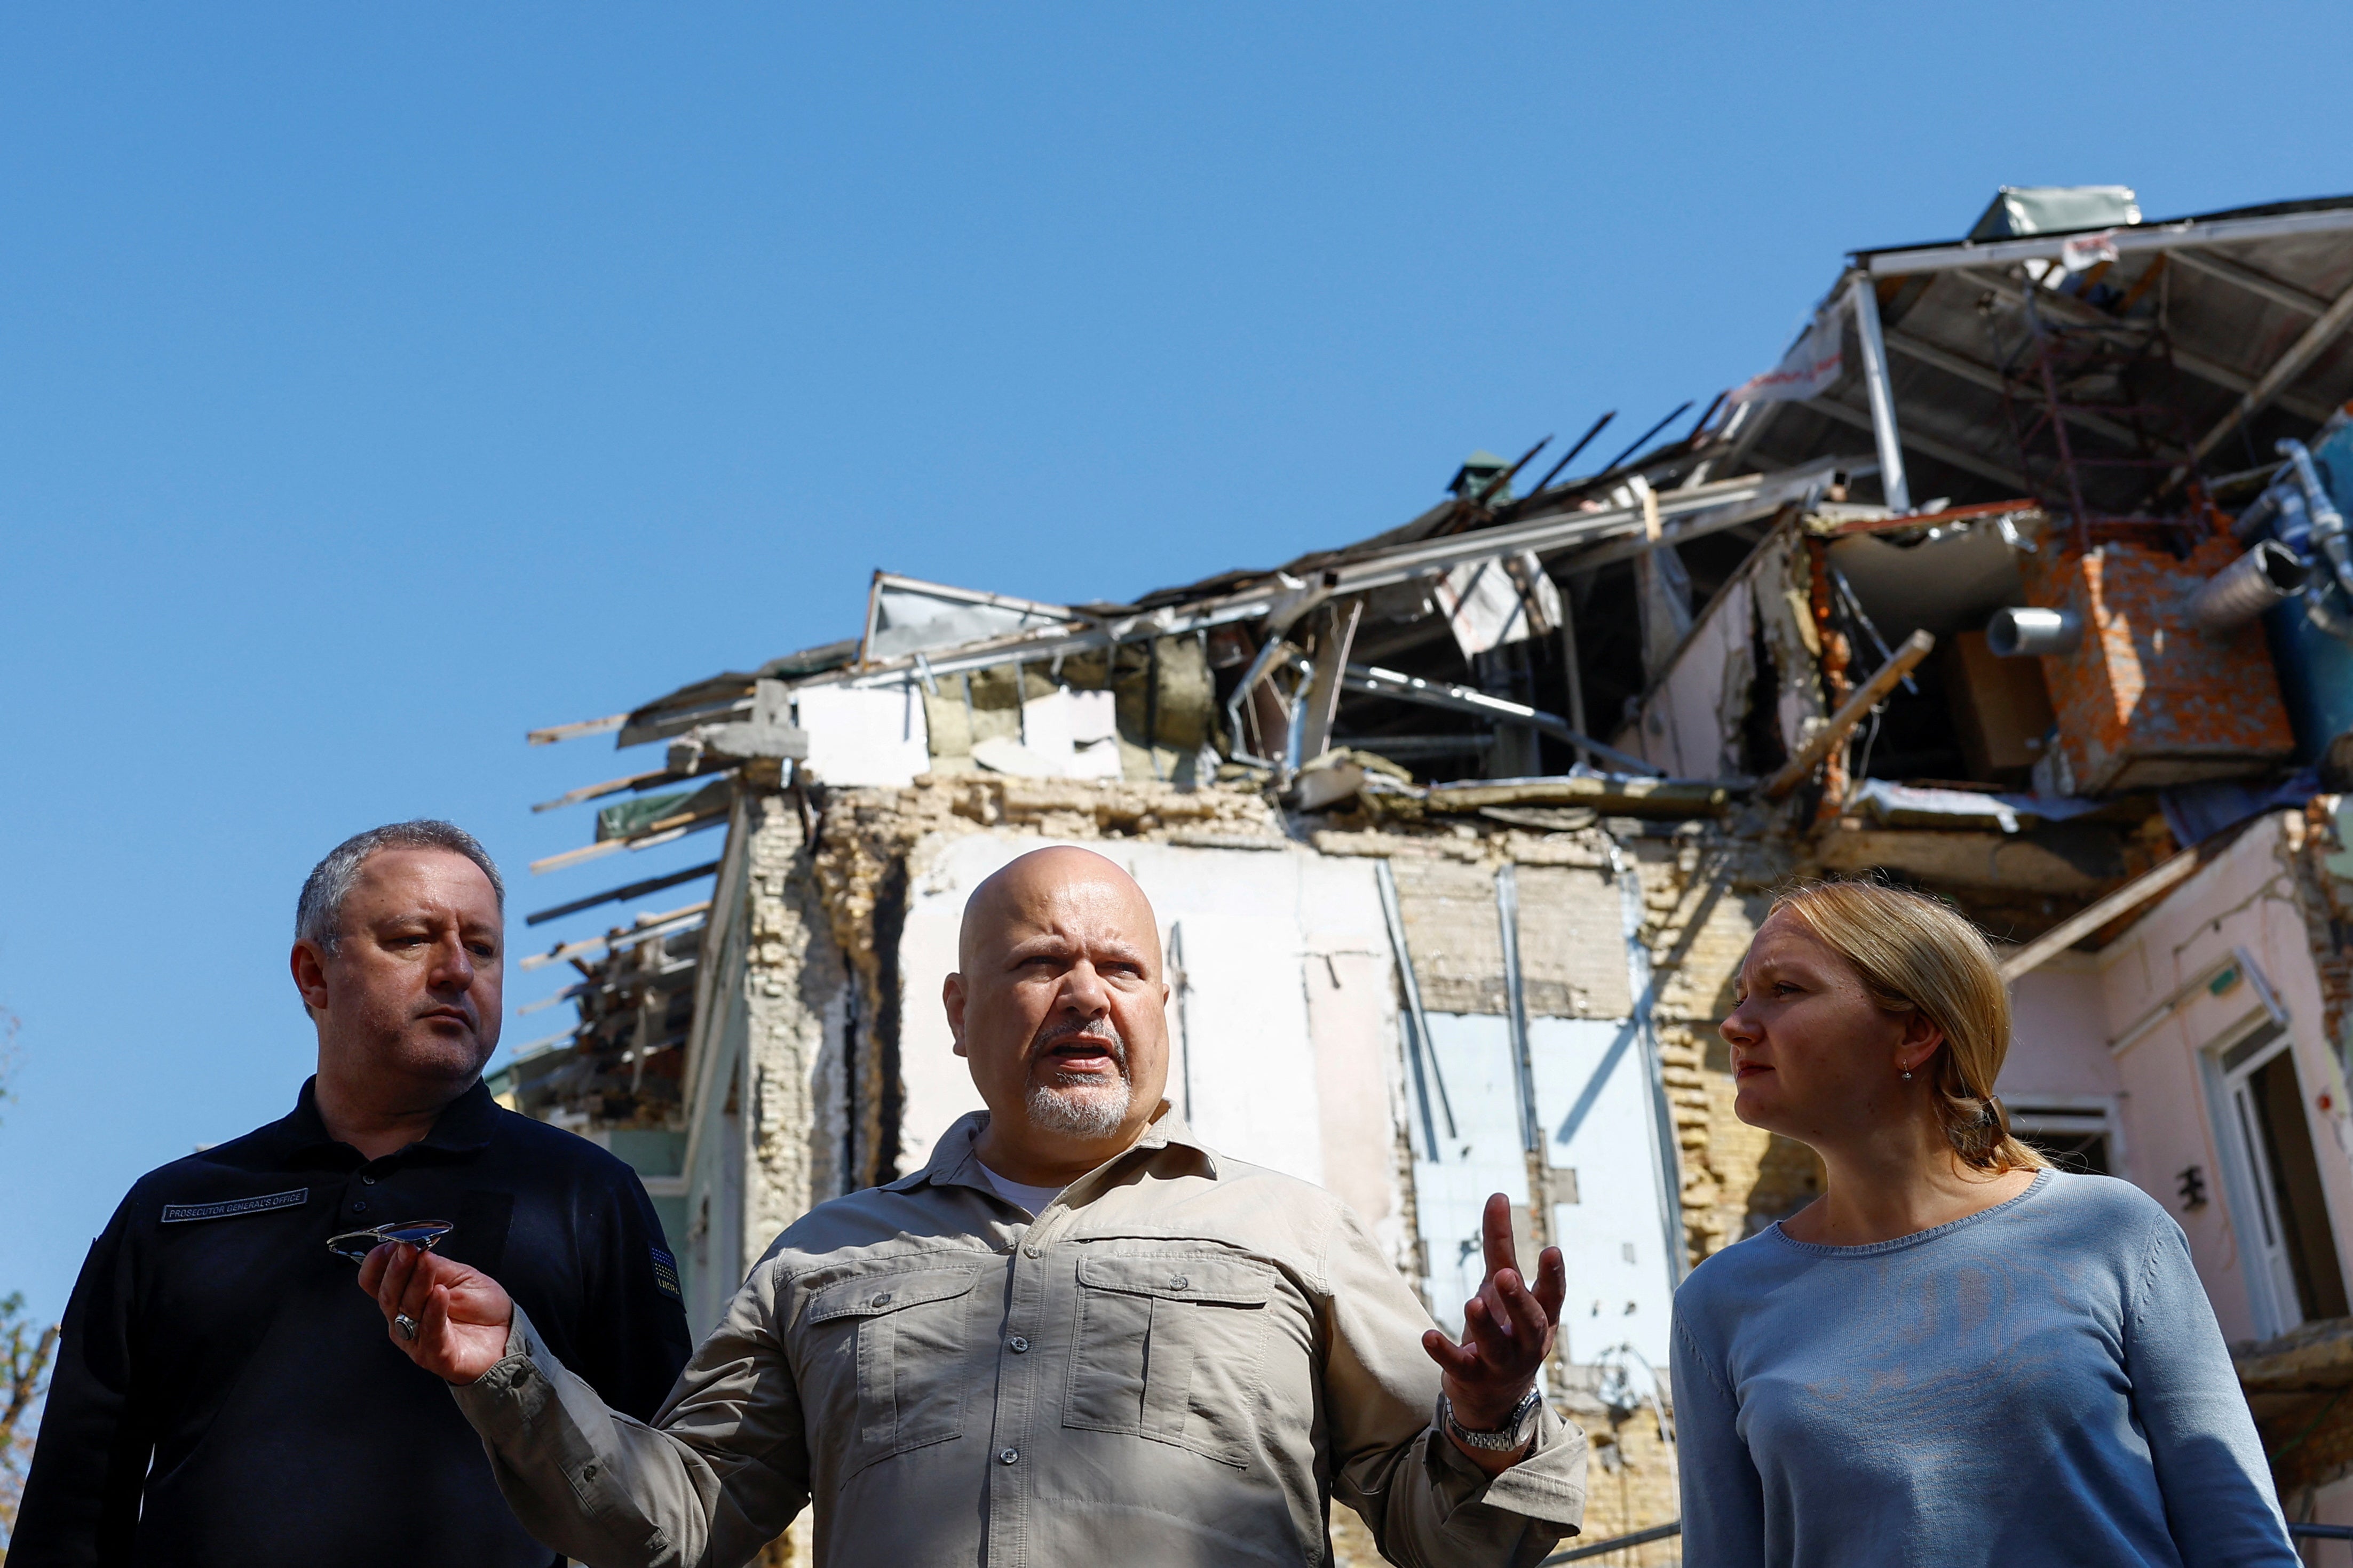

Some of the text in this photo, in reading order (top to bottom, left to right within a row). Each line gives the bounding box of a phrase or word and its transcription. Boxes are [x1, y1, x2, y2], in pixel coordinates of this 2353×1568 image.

[169, 1193, 301, 1218] PROSECUTOR GENERAL'S OFFICE
